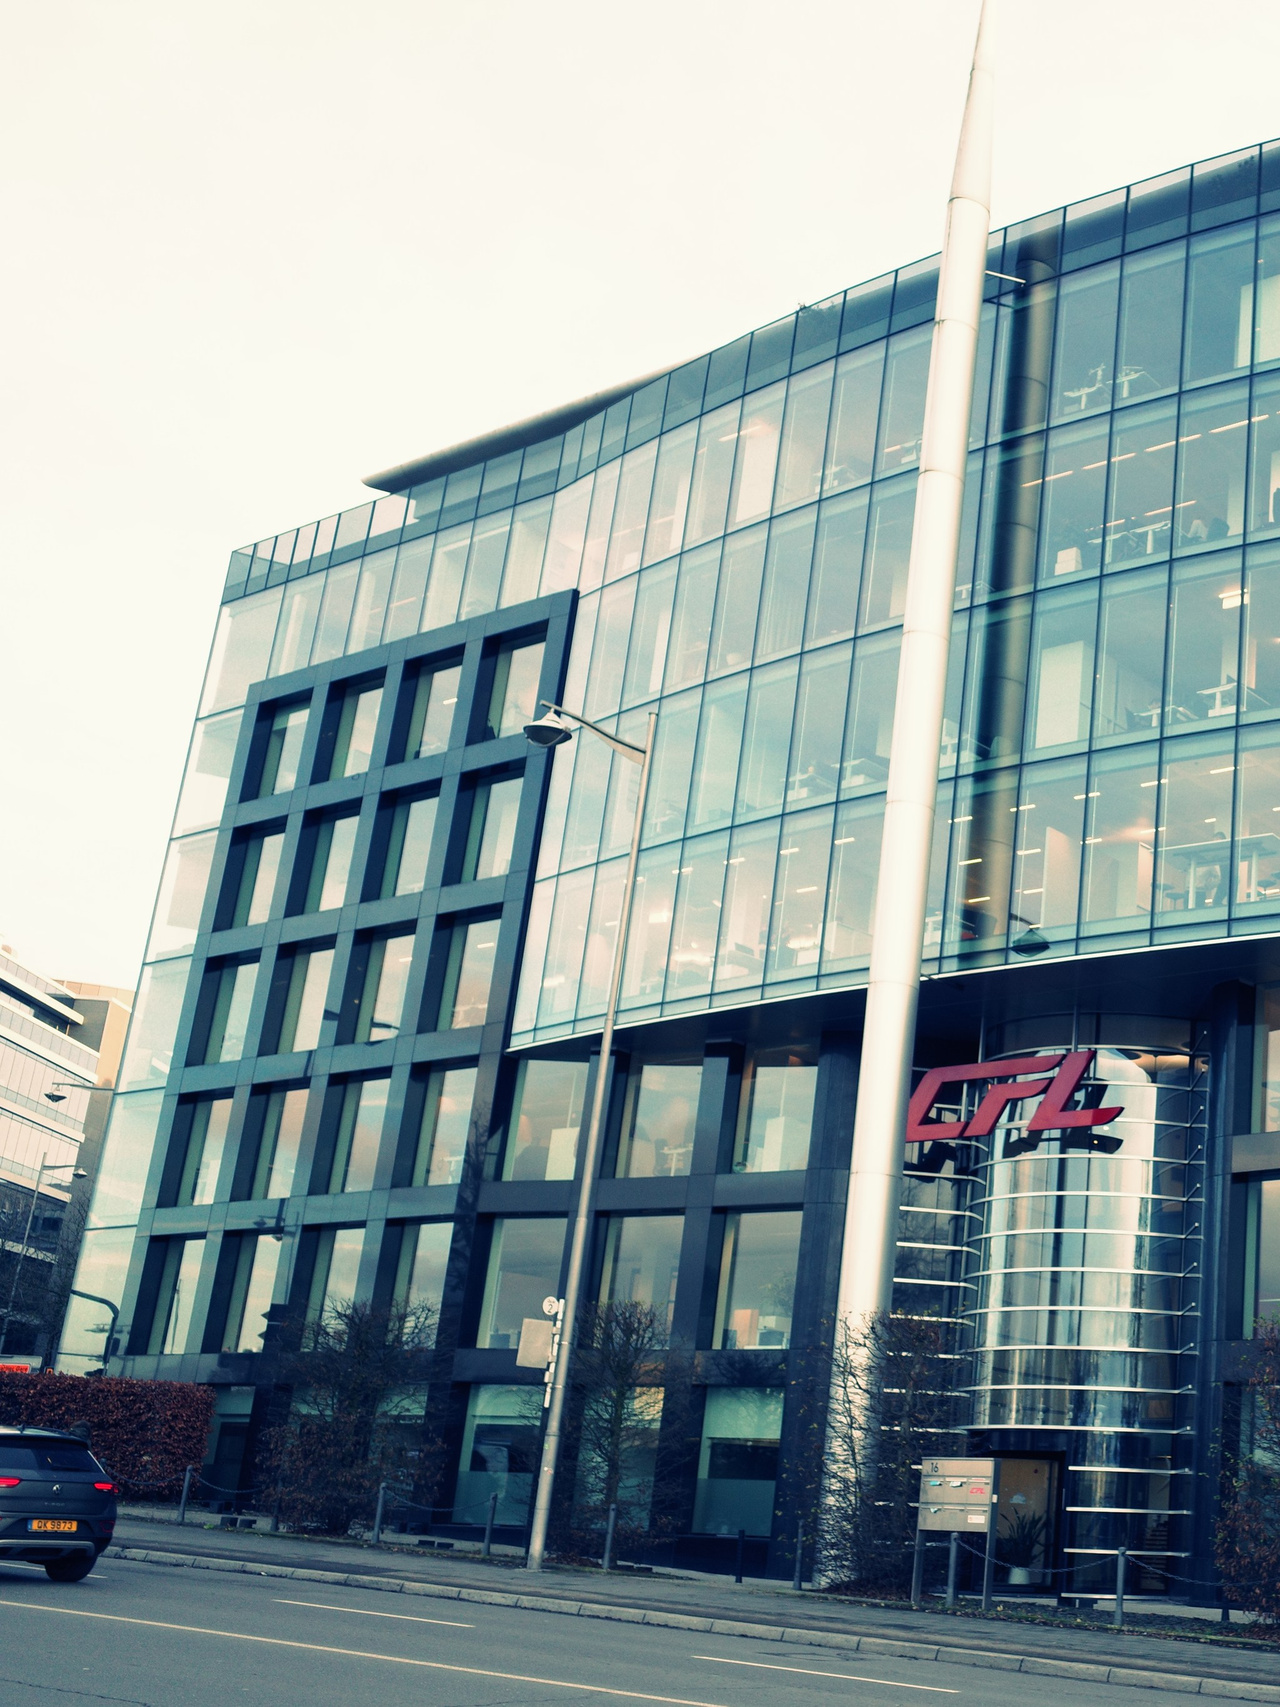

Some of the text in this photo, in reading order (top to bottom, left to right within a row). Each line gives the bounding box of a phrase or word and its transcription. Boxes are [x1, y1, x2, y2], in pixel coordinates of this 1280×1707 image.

[906, 1050, 1124, 1143] CFL
[548, 1304, 553, 1313] 2
[931, 1462, 939, 1473] 16
[37, 1520, 73, 1530] QK 9873
